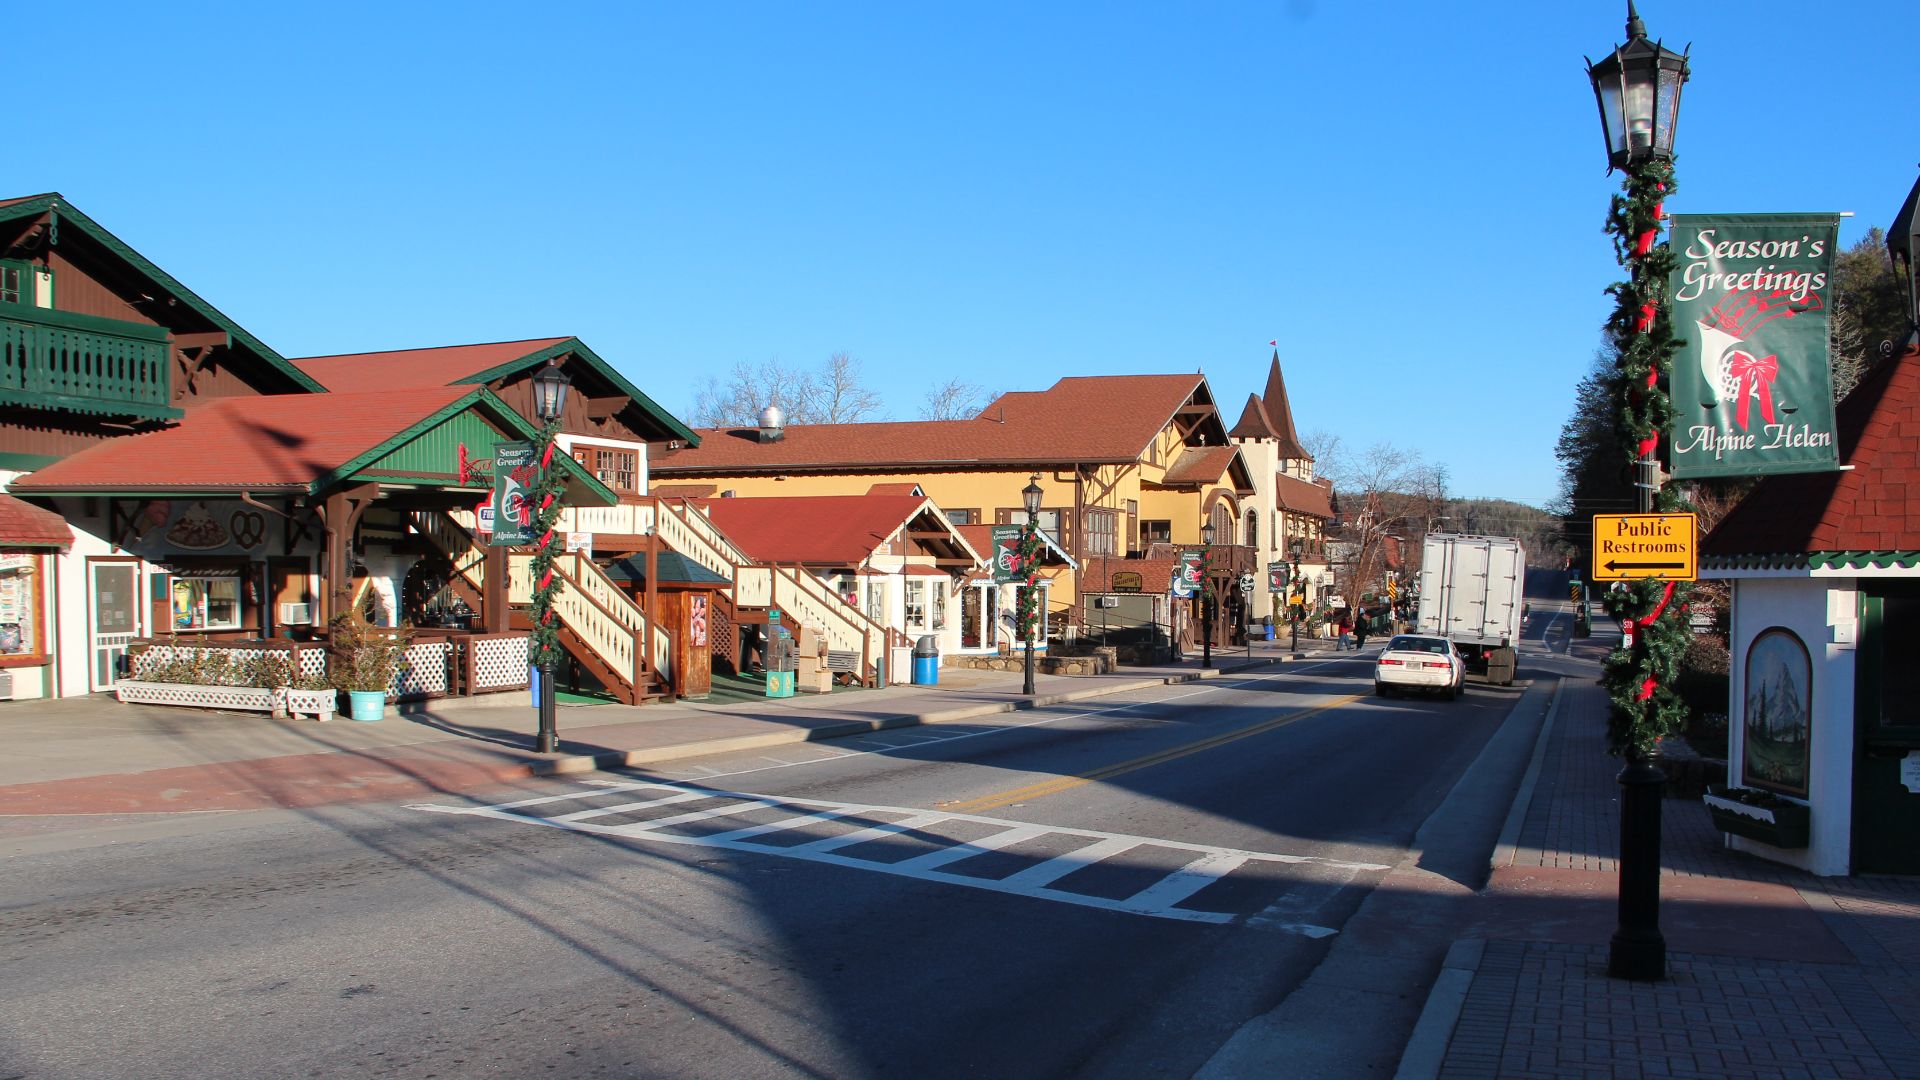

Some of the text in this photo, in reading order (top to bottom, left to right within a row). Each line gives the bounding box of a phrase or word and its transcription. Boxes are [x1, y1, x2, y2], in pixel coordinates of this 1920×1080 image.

[1685, 229, 1824, 259] Season's
[1675, 261, 1826, 301] Greetings
[1674, 424, 1832, 460] Alpine Helen
[1617, 521, 1671, 536] Public
[1602, 539, 1686, 553] Restrooms
